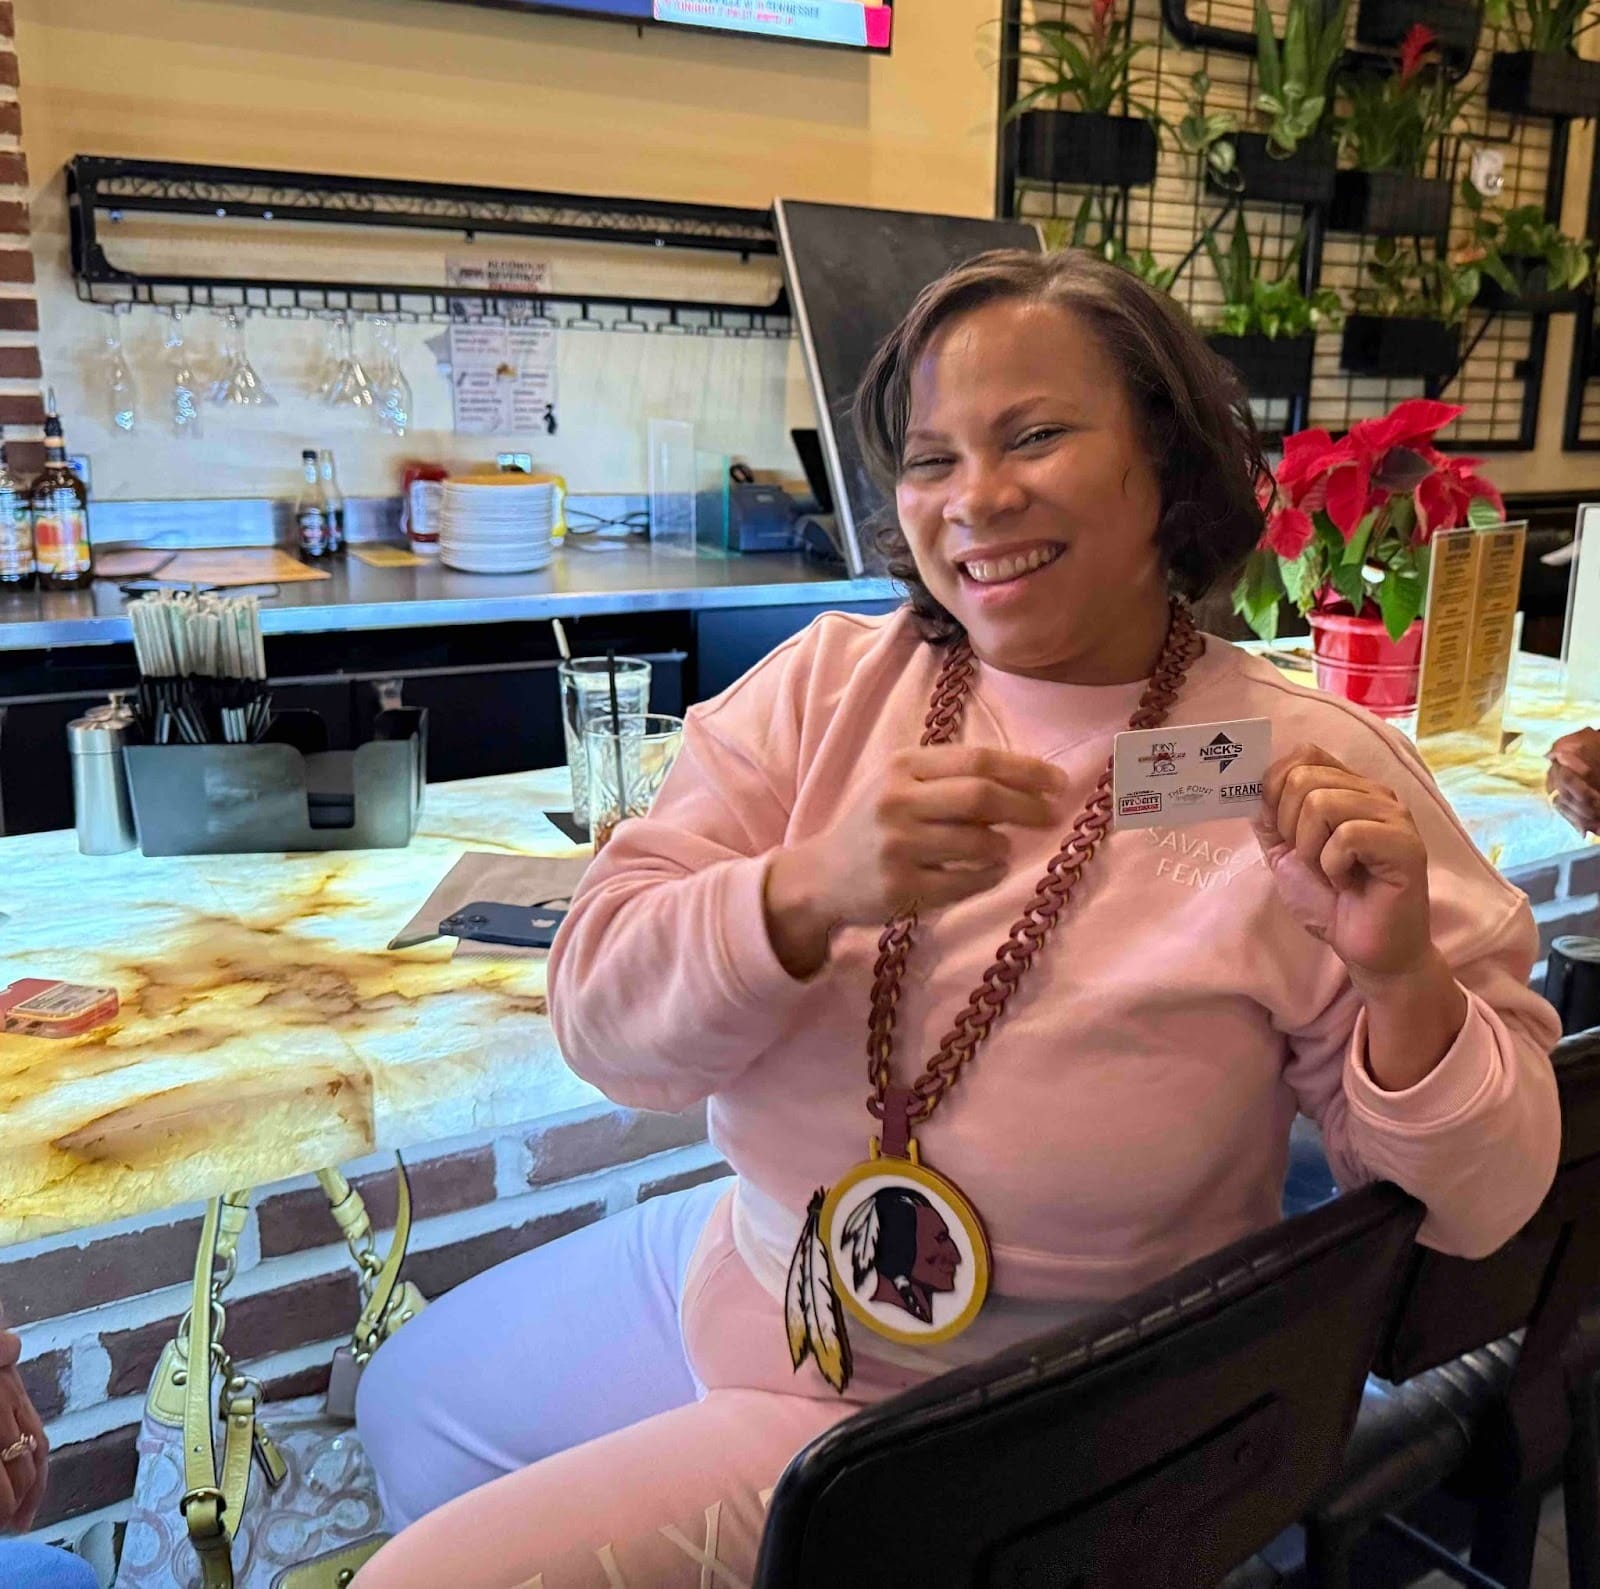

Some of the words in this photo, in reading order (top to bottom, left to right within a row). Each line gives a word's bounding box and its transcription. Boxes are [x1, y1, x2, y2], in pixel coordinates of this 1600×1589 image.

[1200, 744, 1243, 757] NICK'S
[1142, 796, 1159, 804] CITY
[1155, 857, 1239, 889] FENTY
